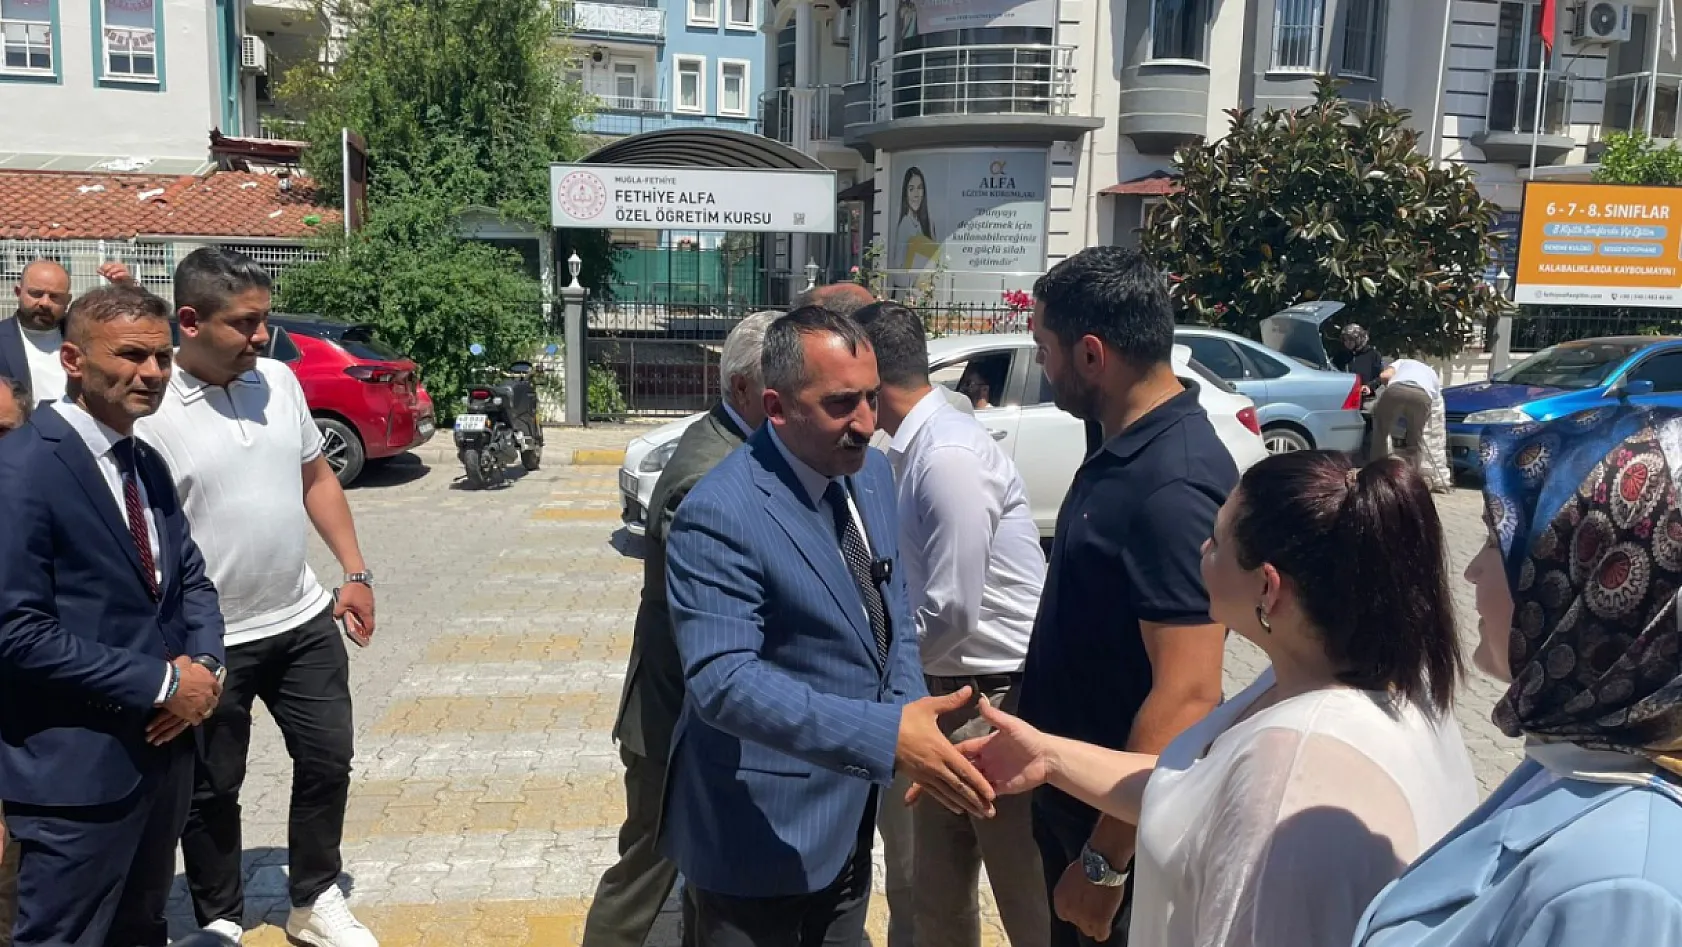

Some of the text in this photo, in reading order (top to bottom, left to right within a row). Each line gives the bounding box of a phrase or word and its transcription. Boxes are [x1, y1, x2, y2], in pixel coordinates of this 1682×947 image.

[615, 175, 677, 186] MUĞLA-FETHİYE
[979, 177, 1016, 189] ALFA
[615, 187, 716, 205] FETHİYE ALFA
[615, 206, 772, 225] ÖZEL ÖĞRETİM KURSU
[1546, 202, 1556, 216] 6
[1567, 203, 1577, 216] 7
[1588, 203, 1601, 218] 8.
[1604, 204, 1670, 219] SINIFLAR
[957, 221, 1033, 231] değiştirmek için
[952, 233, 1037, 243] kullanabileceğiniz
[962, 245, 1026, 256] en güçlü silah
[1538, 264, 1611, 274] KALABALIKLARDA
[1613, 265, 1672, 276] KAYBOLMAYIN
